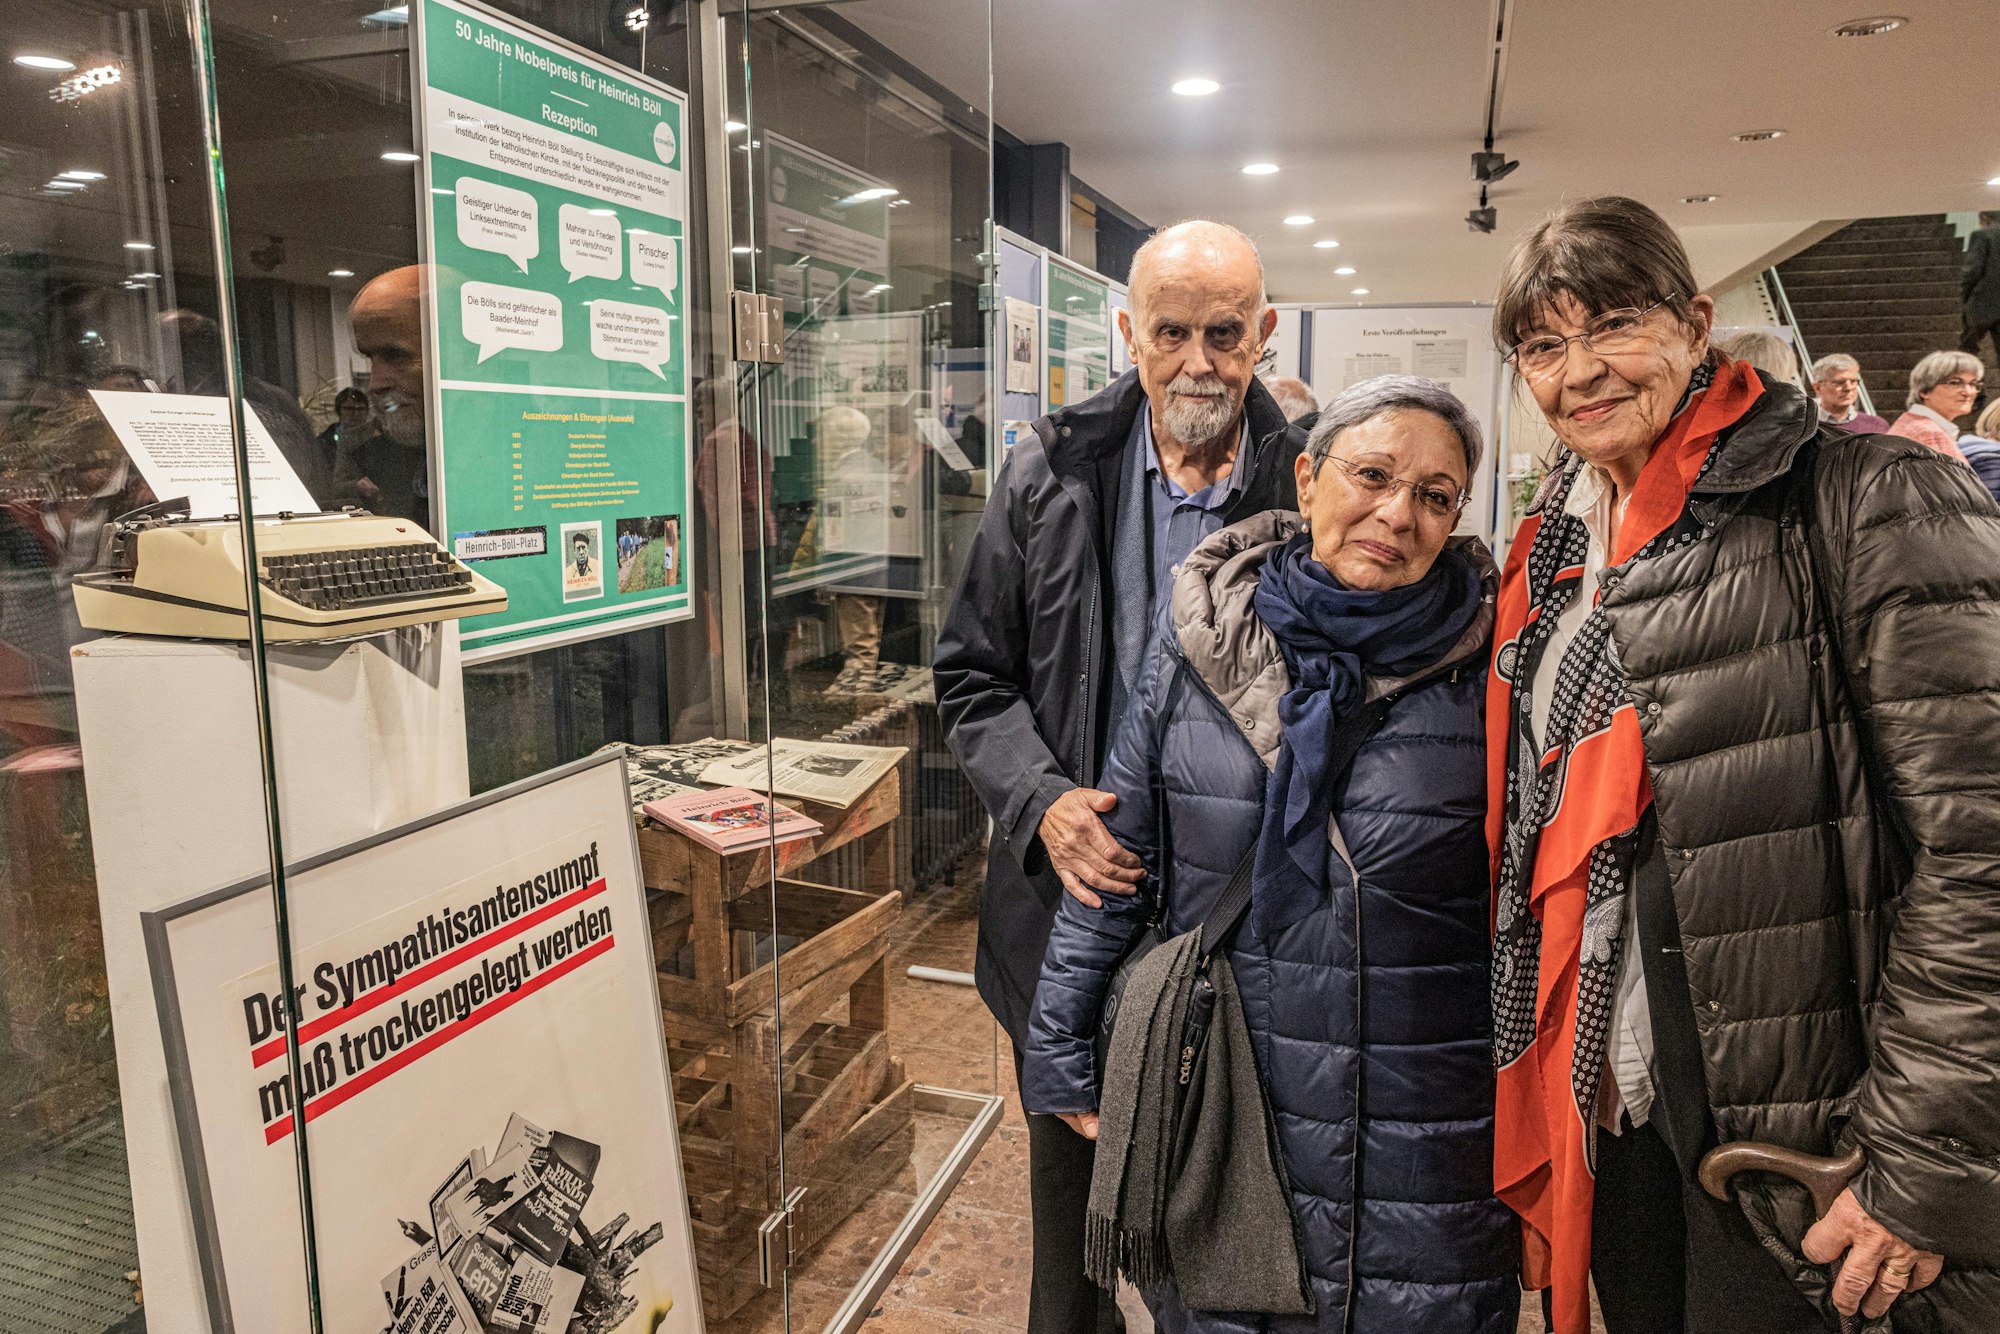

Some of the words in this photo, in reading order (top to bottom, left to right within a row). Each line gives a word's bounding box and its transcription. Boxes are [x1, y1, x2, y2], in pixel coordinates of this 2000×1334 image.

[455, 19, 472, 41] 50
[475, 28, 512, 57] Jahre
[515, 45, 578, 84] Nobelpreis
[580, 71, 596, 91] für
[599, 78, 640, 108] Heinrich
[643, 97, 662, 117] Böll
[542, 103, 598, 137] Rezeption
[448, 108, 455, 118] In
[483, 120, 500, 132] Werk
[501, 125, 521, 141] bezog
[522, 132, 547, 148] Heinrich
[548, 141, 559, 151] Böll
[560, 144, 584, 160] Stellung.
[586, 152, 593, 161] Er
[593, 155, 624, 173] beschäftigte
[625, 166, 636, 177] sich
[636, 168, 653, 181] kritisch
[653, 174, 661, 183] mit
[662, 177, 670, 186] der
[455, 125, 488, 144] Institution
[489, 136, 500, 146] der
[501, 140, 540, 158] katholischen
[540, 152, 561, 166] Kirche,
[562, 159, 571, 168] mit
[572, 161, 581, 171] der
[582, 165, 626, 185] Nachkriegspolitik
[627, 177, 636, 189] und
[637, 181, 647, 191] den
[489, 149, 533, 171] Entsprechend
[533, 164, 577, 183] unterschiedlich
[578, 178, 594, 189] wurde
[601, 184, 642, 202] wahrgenommen.
[462, 194, 493, 211] Geistiger
[494, 202, 520, 217] Urheber
[520, 210, 532, 220] des
[469, 210, 527, 232] Linksextremismus
[565, 222, 588, 236] Mahner
[588, 228, 595, 236] zu
[595, 229, 616, 242] Frieden
[569, 238, 580, 247] und
[581, 239, 613, 255] Versöhnung
[638, 243, 669, 260] Pinscher
[467, 295, 479, 306] Die
[480, 297, 497, 308] Bölls
[498, 301, 511, 310] sind
[512, 303, 547, 316] gefährlicher
[548, 308, 557, 317] als
[600, 308, 615, 318] Seine
[489, 312, 539, 327] Baader-Meinhof
[596, 322, 613, 331] wache
[614, 324, 623, 332] und
[624, 325, 640, 334] immer
[640, 328, 665, 338] mahnende
[602, 333, 622, 344] Stimme
[622, 337, 633, 345] wird
[633, 338, 643, 346] uns
[1363, 329, 1381, 337] Erste
[1382, 328, 1447, 337] Veröffentlichungen
[522, 411, 573, 422] Auszeichnungen
[574, 412, 579, 421] &
[580, 413, 606, 423] Ehrungen
[607, 414, 635, 424] (Auswahl)
[465, 538, 538, 554] Heinrich-Böll-Platz
[567, 577, 587, 585] HEINRICH
[681, 800, 729, 813] Heinrich
[243, 983, 307, 1046] Der
[313, 841, 600, 1012] Sympathisantensumpf
[258, 1041, 337, 1124] muß
[340, 941, 530, 1076] trockengelegt
[533, 905, 613, 969] werden
[544, 1163, 587, 1202] BRANDT
[556, 1162, 586, 1188] WILLY
[540, 1172, 581, 1211] Begegnungen
[550, 1193, 564, 1205] und
[525, 1198, 541, 1218] 1960
[534, 1199, 547, 1214] Die
[546, 1211, 564, 1226] Jahre
[537, 1190, 570, 1220] Einsichten
[552, 1223, 568, 1237] 1975
[410, 1243, 436, 1270] Grass
[472, 1242, 507, 1281] Siegfried
[460, 1253, 499, 1304] Lenz
[397, 1296, 425, 1334] Heinrich
[420, 1276, 436, 1302] Böll
[497, 1274, 523, 1312] Heinrich
[510, 1296, 528, 1317] Böll
